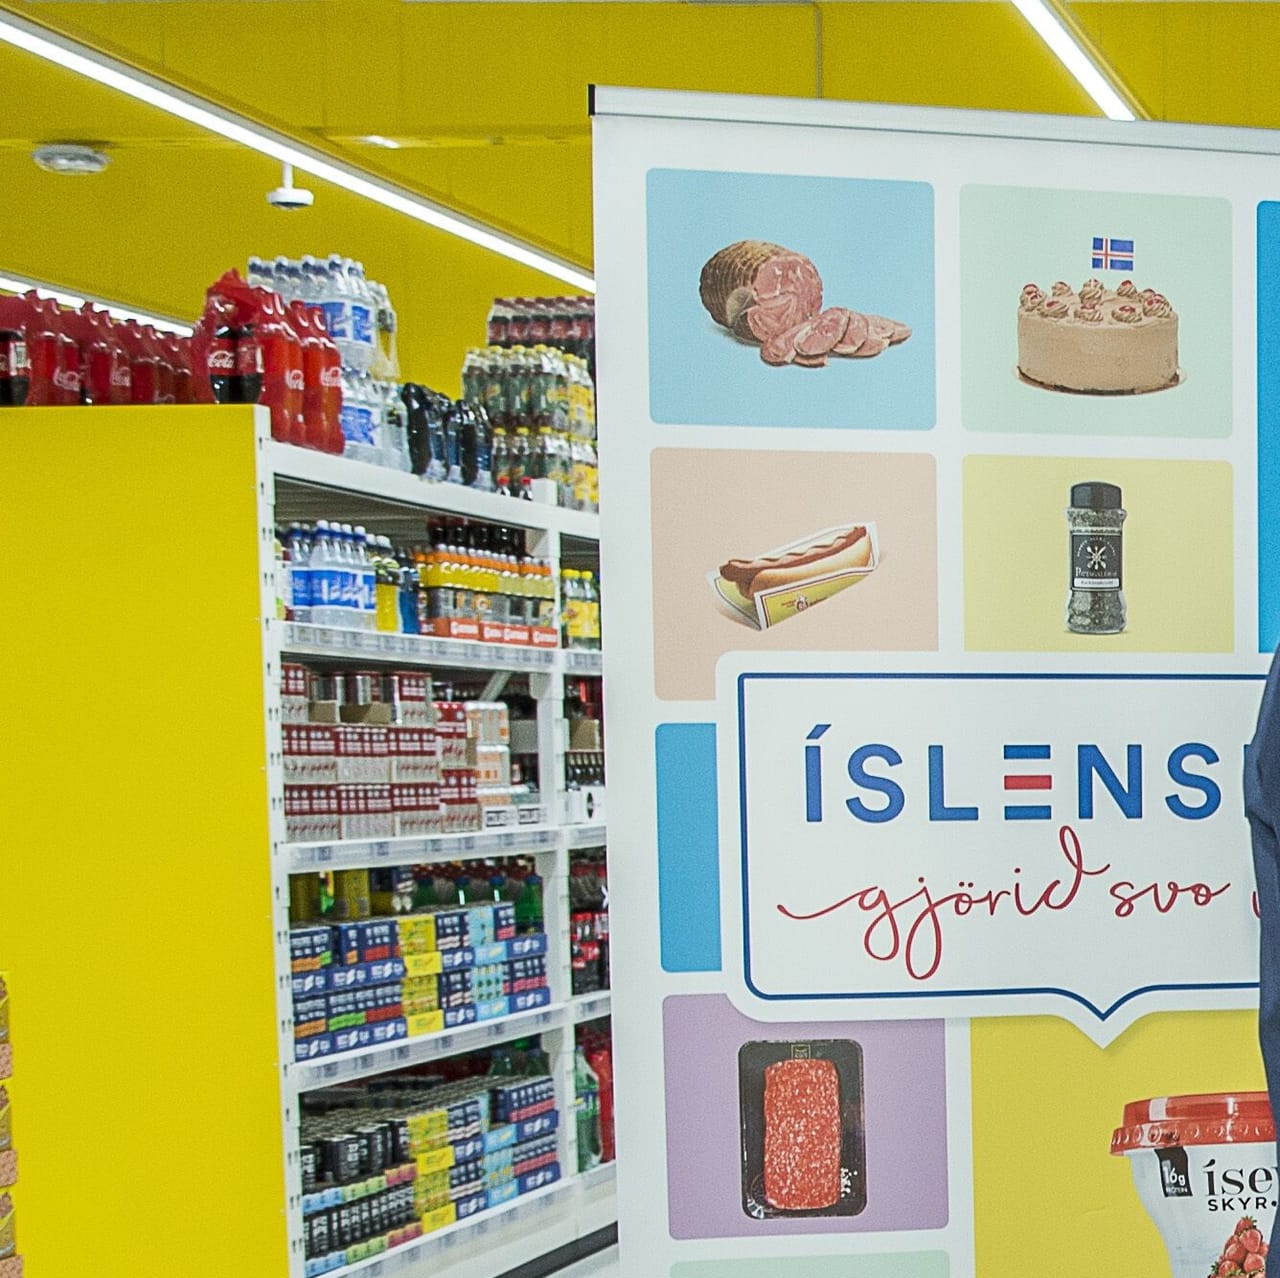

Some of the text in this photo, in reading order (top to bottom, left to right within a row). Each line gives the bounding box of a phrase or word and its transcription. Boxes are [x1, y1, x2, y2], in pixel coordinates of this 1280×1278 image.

[804, 723, 1251, 823] ÍSLENS
[1110, 881, 1231, 917] svo
[1162, 1160, 1186, 1187] 16g
[1203, 1158, 1278, 1197] íse
[1208, 1197, 1268, 1212] SKYR
